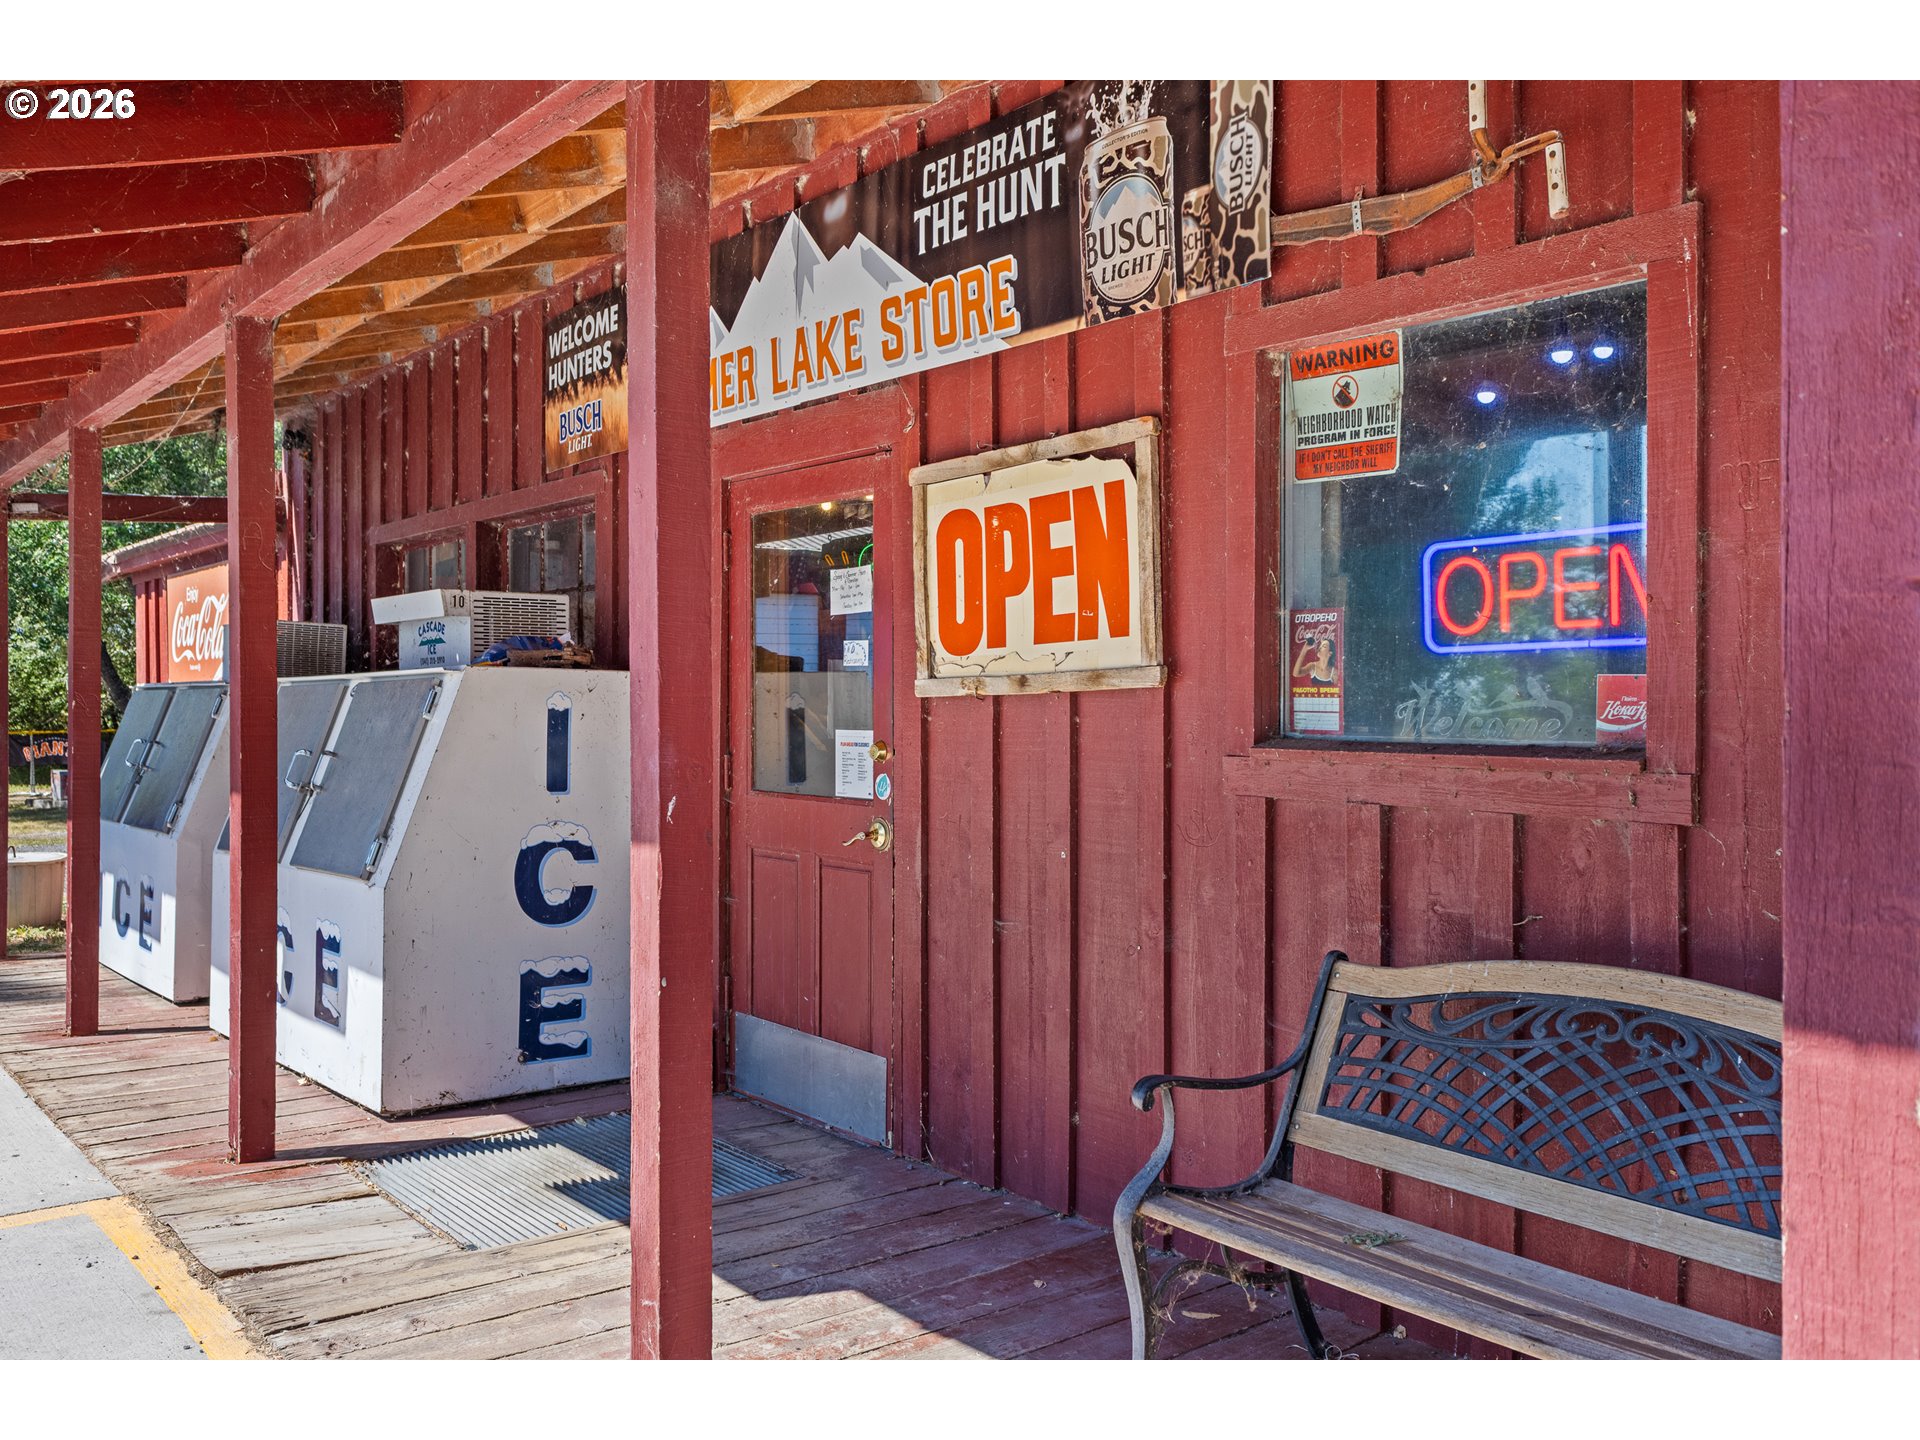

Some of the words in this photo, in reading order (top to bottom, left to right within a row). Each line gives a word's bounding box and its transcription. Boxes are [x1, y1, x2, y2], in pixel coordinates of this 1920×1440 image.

[1130, 128, 1148, 139] EDITION
[923, 110, 1056, 199] CELEBRATE
[1229, 112, 1247, 215] BUSCH
[1244, 134, 1254, 187] LIGHT
[914, 191, 968, 255] THE
[976, 153, 1066, 233] HUNT
[1086, 207, 1169, 270] BUSCH
[1101, 253, 1156, 285] LIGHT
[548, 304, 619, 359] WELCOME
[770, 307, 864, 395] LAKE
[880, 256, 1018, 363] STORE
[548, 340, 612, 391] HUNTERS
[1295, 339, 1395, 373] WARNING
[559, 399, 603, 444] BUSCH
[1297, 407, 1363, 436] NEIGHBORHOOD
[1366, 402, 1397, 426] WATCH
[1297, 431, 1347, 447] PROGRAM
[1350, 429, 1361, 440] IN
[1364, 423, 1396, 439] FORCE
[567, 433, 593, 455] LIGHT
[1299, 453, 1306, 464] IF
[1311, 449, 1332, 462] DON'T
[1333, 447, 1349, 459] CALL
[1350, 446, 1363, 457] THE
[1365, 442, 1394, 455] SHERIFF
[1313, 464, 1323, 474] MY
[1325, 459, 1359, 473] NEIGHBOR
[1361, 457, 1377, 468] WILL
[936, 479, 1130, 657] OPEN
[186, 586, 199, 603] Enjoy
[452, 594, 465, 608] 10
[1436, 543, 1648, 637] OPEN
[172, 593, 229, 663] Coca-Cola
[418, 620, 445, 637] CASCADE
[1295, 613, 1338, 623] ОТВОРЕНО
[427, 643, 436, 655] ICE
[1396, 698, 1562, 739] Welcome
[514, 691, 599, 1063] ICE
